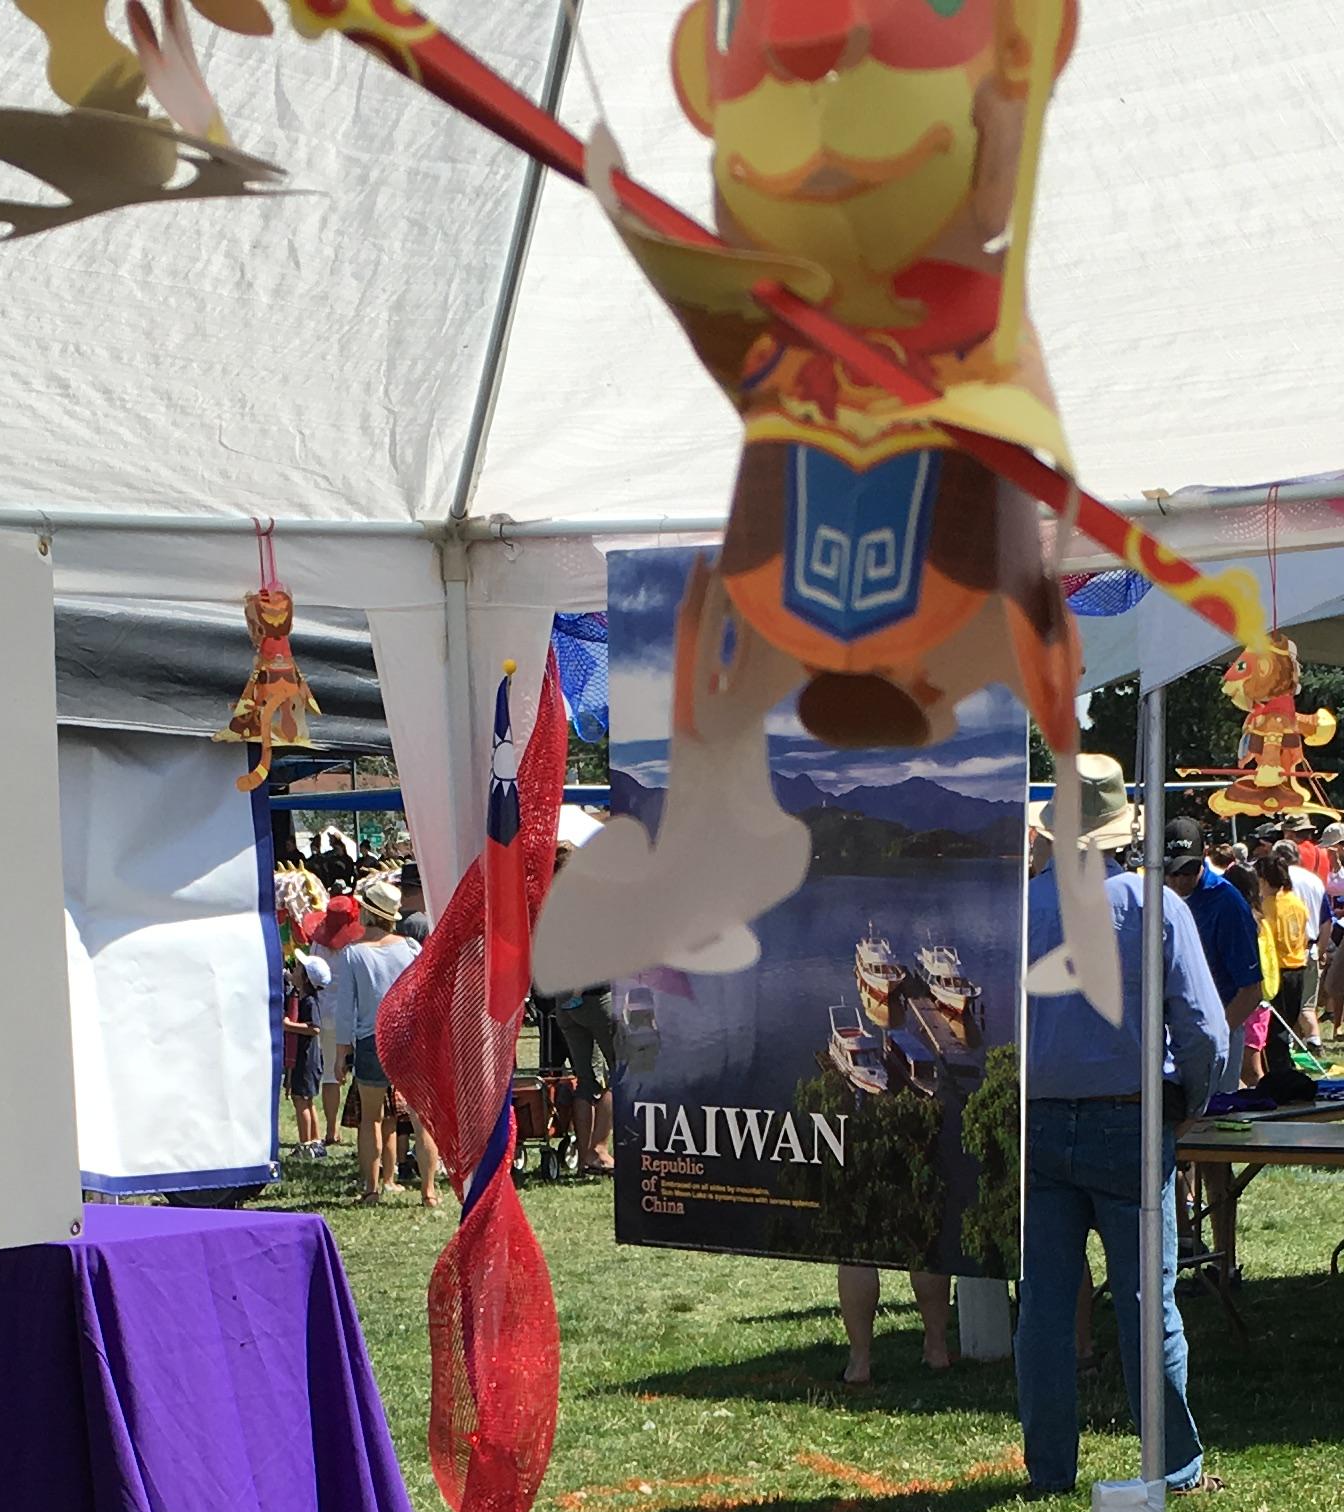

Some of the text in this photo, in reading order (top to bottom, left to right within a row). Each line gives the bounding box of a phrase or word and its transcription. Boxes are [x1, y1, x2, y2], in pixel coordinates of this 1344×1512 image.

[634, 1101, 848, 1167] TAIWAN
[641, 1155, 705, 1176] Republic
[642, 1176, 658, 1192] of
[642, 1195, 685, 1214] China
